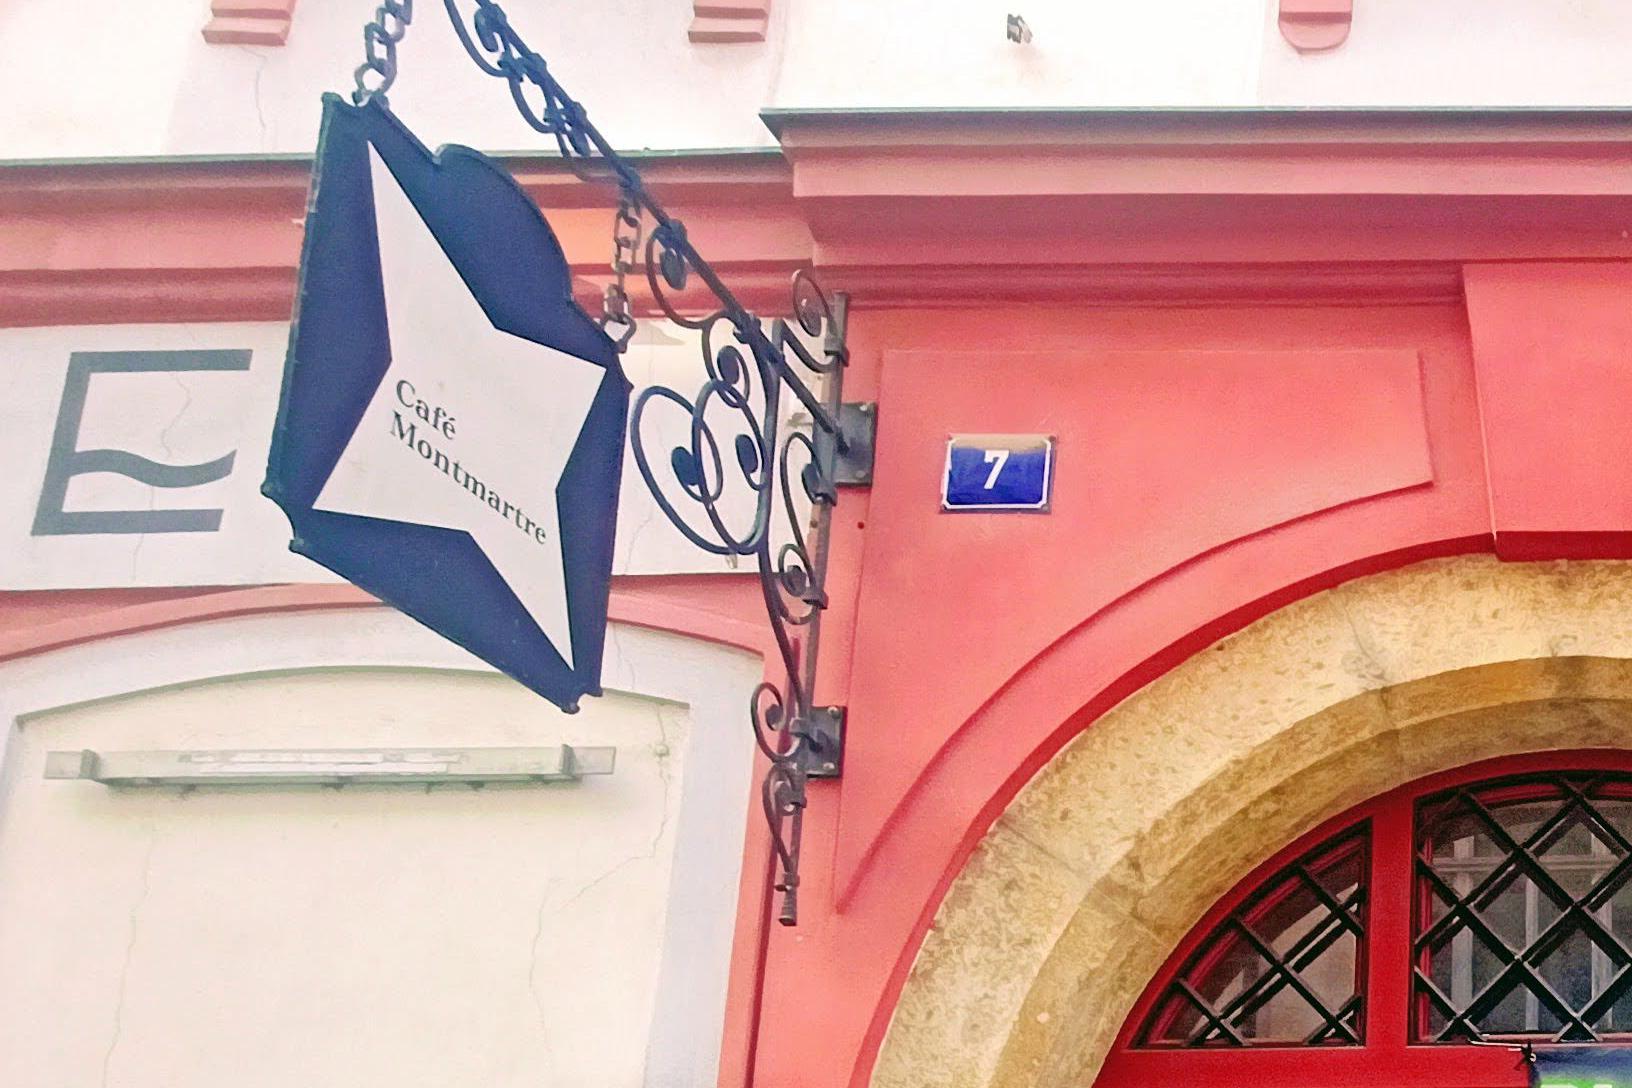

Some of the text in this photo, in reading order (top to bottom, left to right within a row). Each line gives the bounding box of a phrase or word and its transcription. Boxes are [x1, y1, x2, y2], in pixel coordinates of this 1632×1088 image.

[396, 379, 457, 441] Café
[389, 410, 547, 545] Montmartre
[983, 449, 1010, 491] 7
